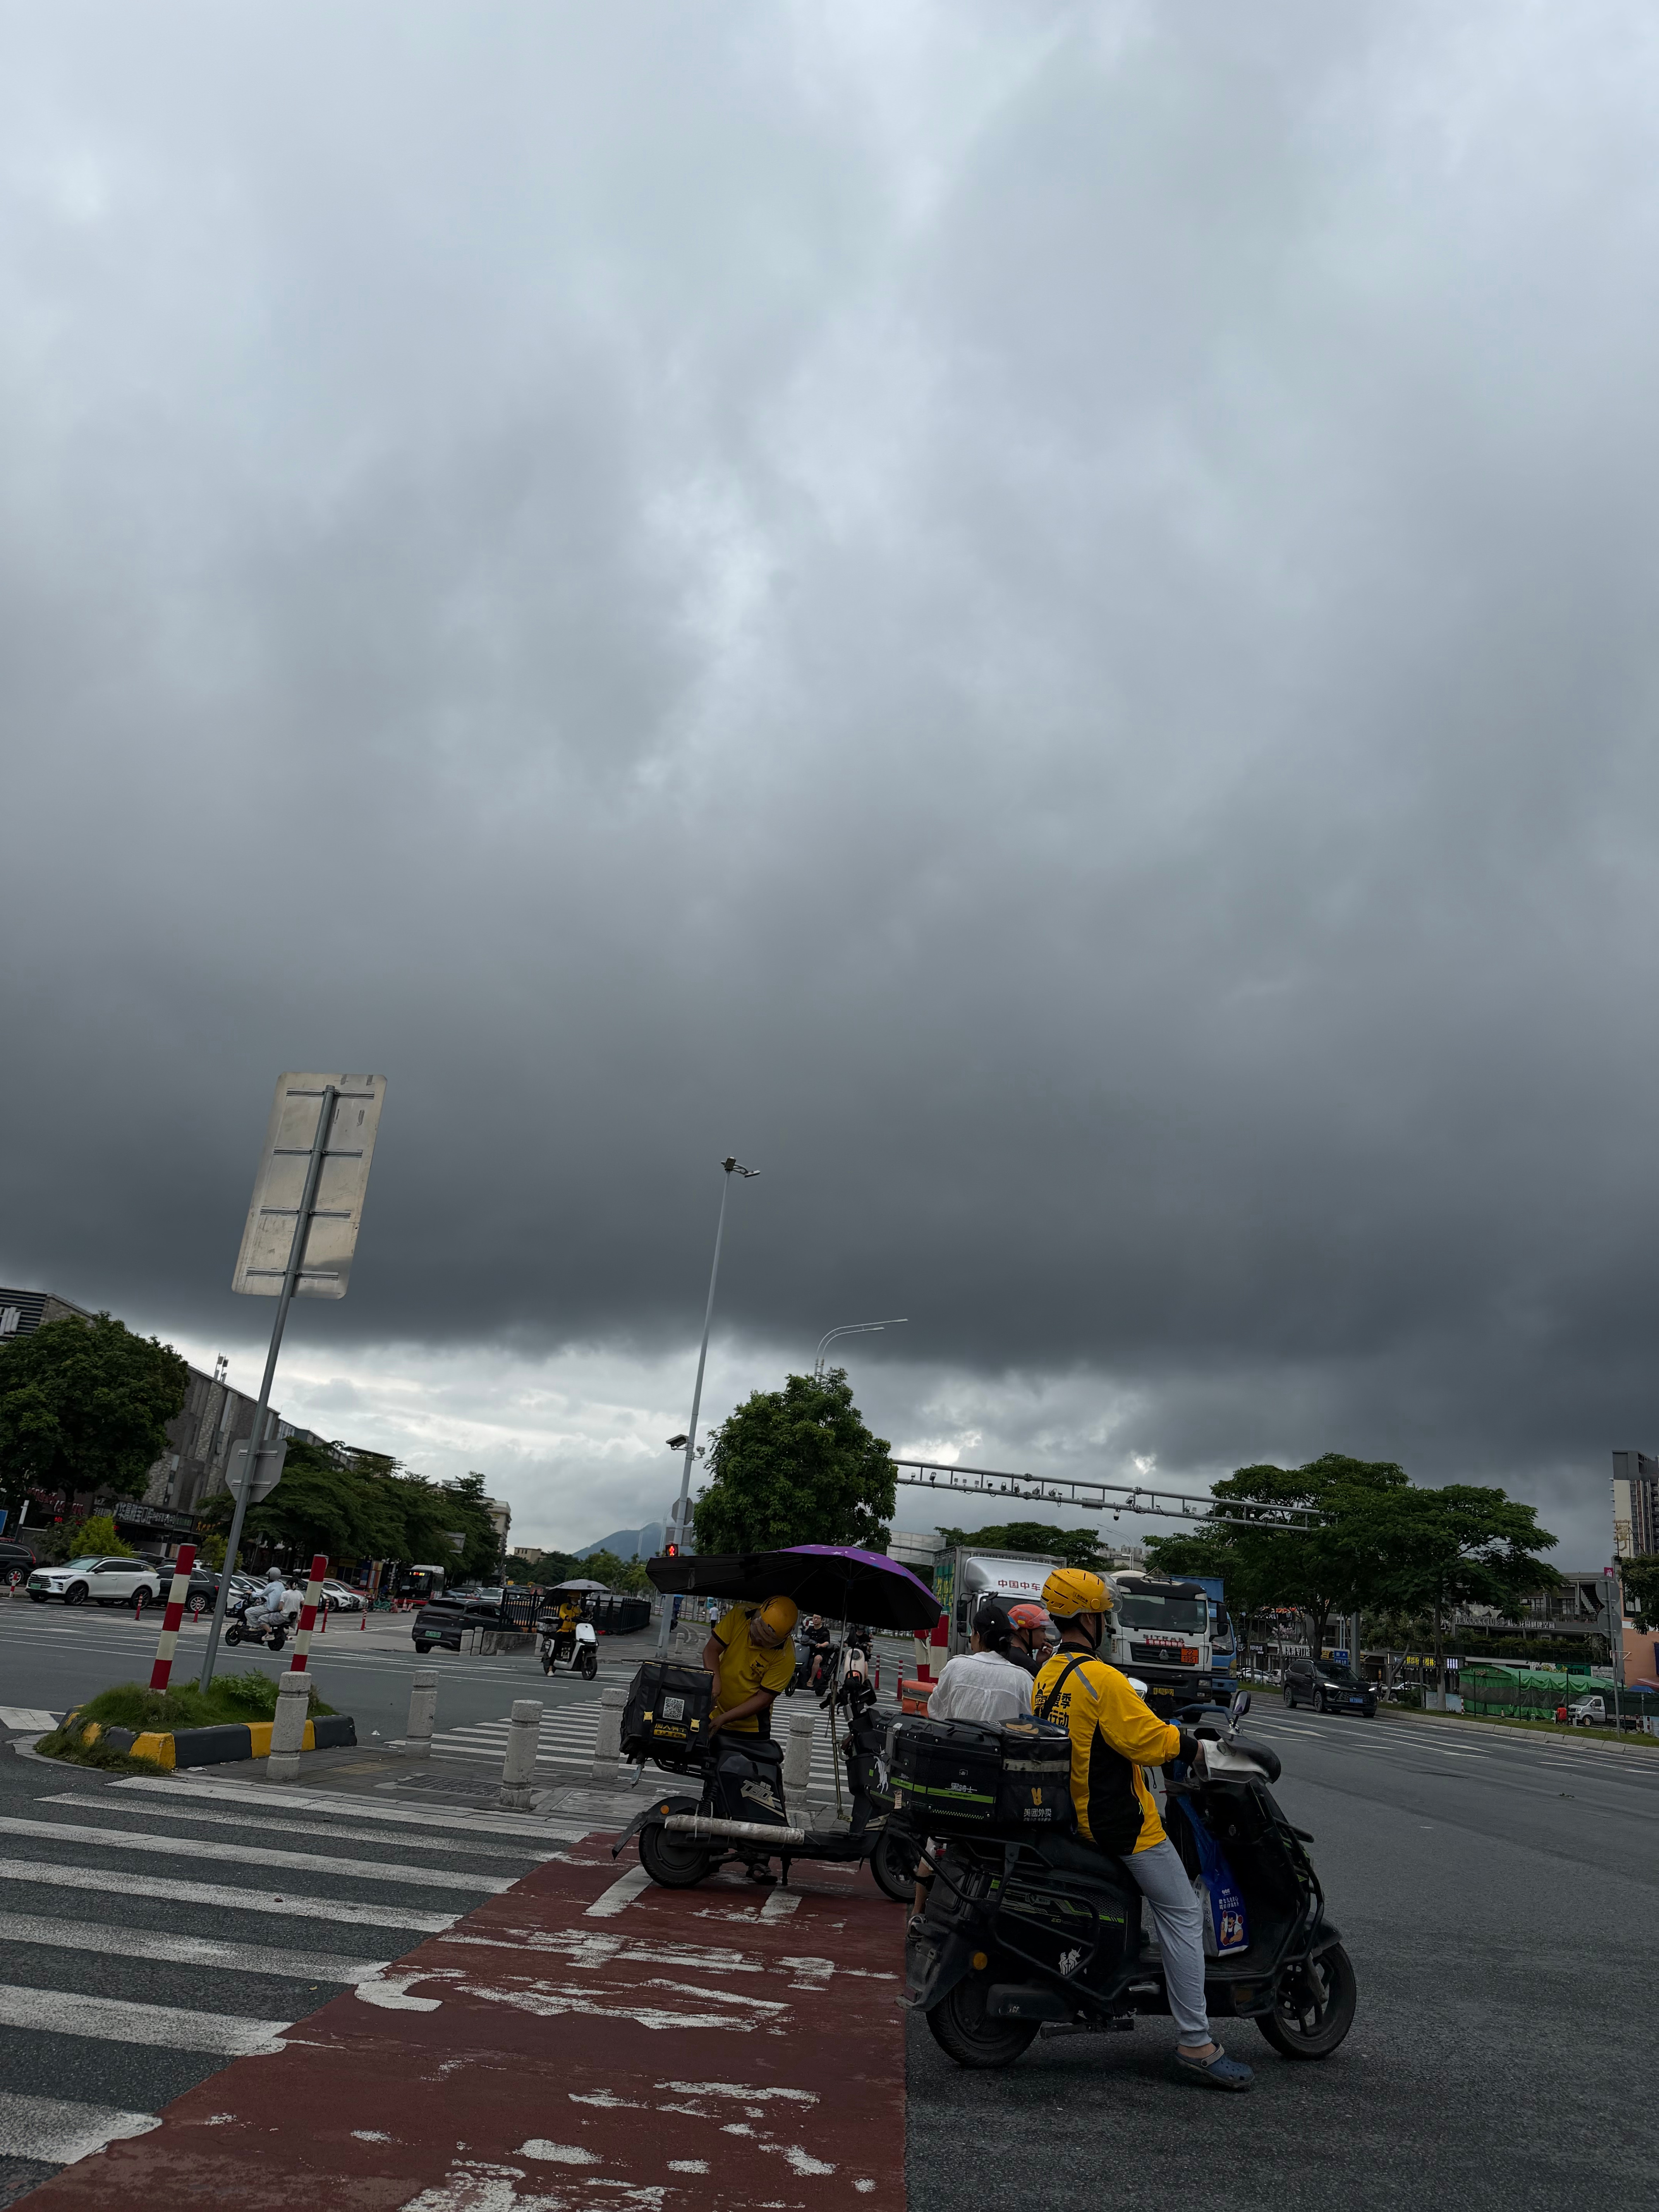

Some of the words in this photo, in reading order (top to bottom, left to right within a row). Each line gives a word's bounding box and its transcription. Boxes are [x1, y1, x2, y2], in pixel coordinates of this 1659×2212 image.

[998, 1580, 1041, 1591] 中国中车
[1455, 1617, 1482, 1625] PEACOCK
[1024, 1808, 1052, 1817] 美团外卖
